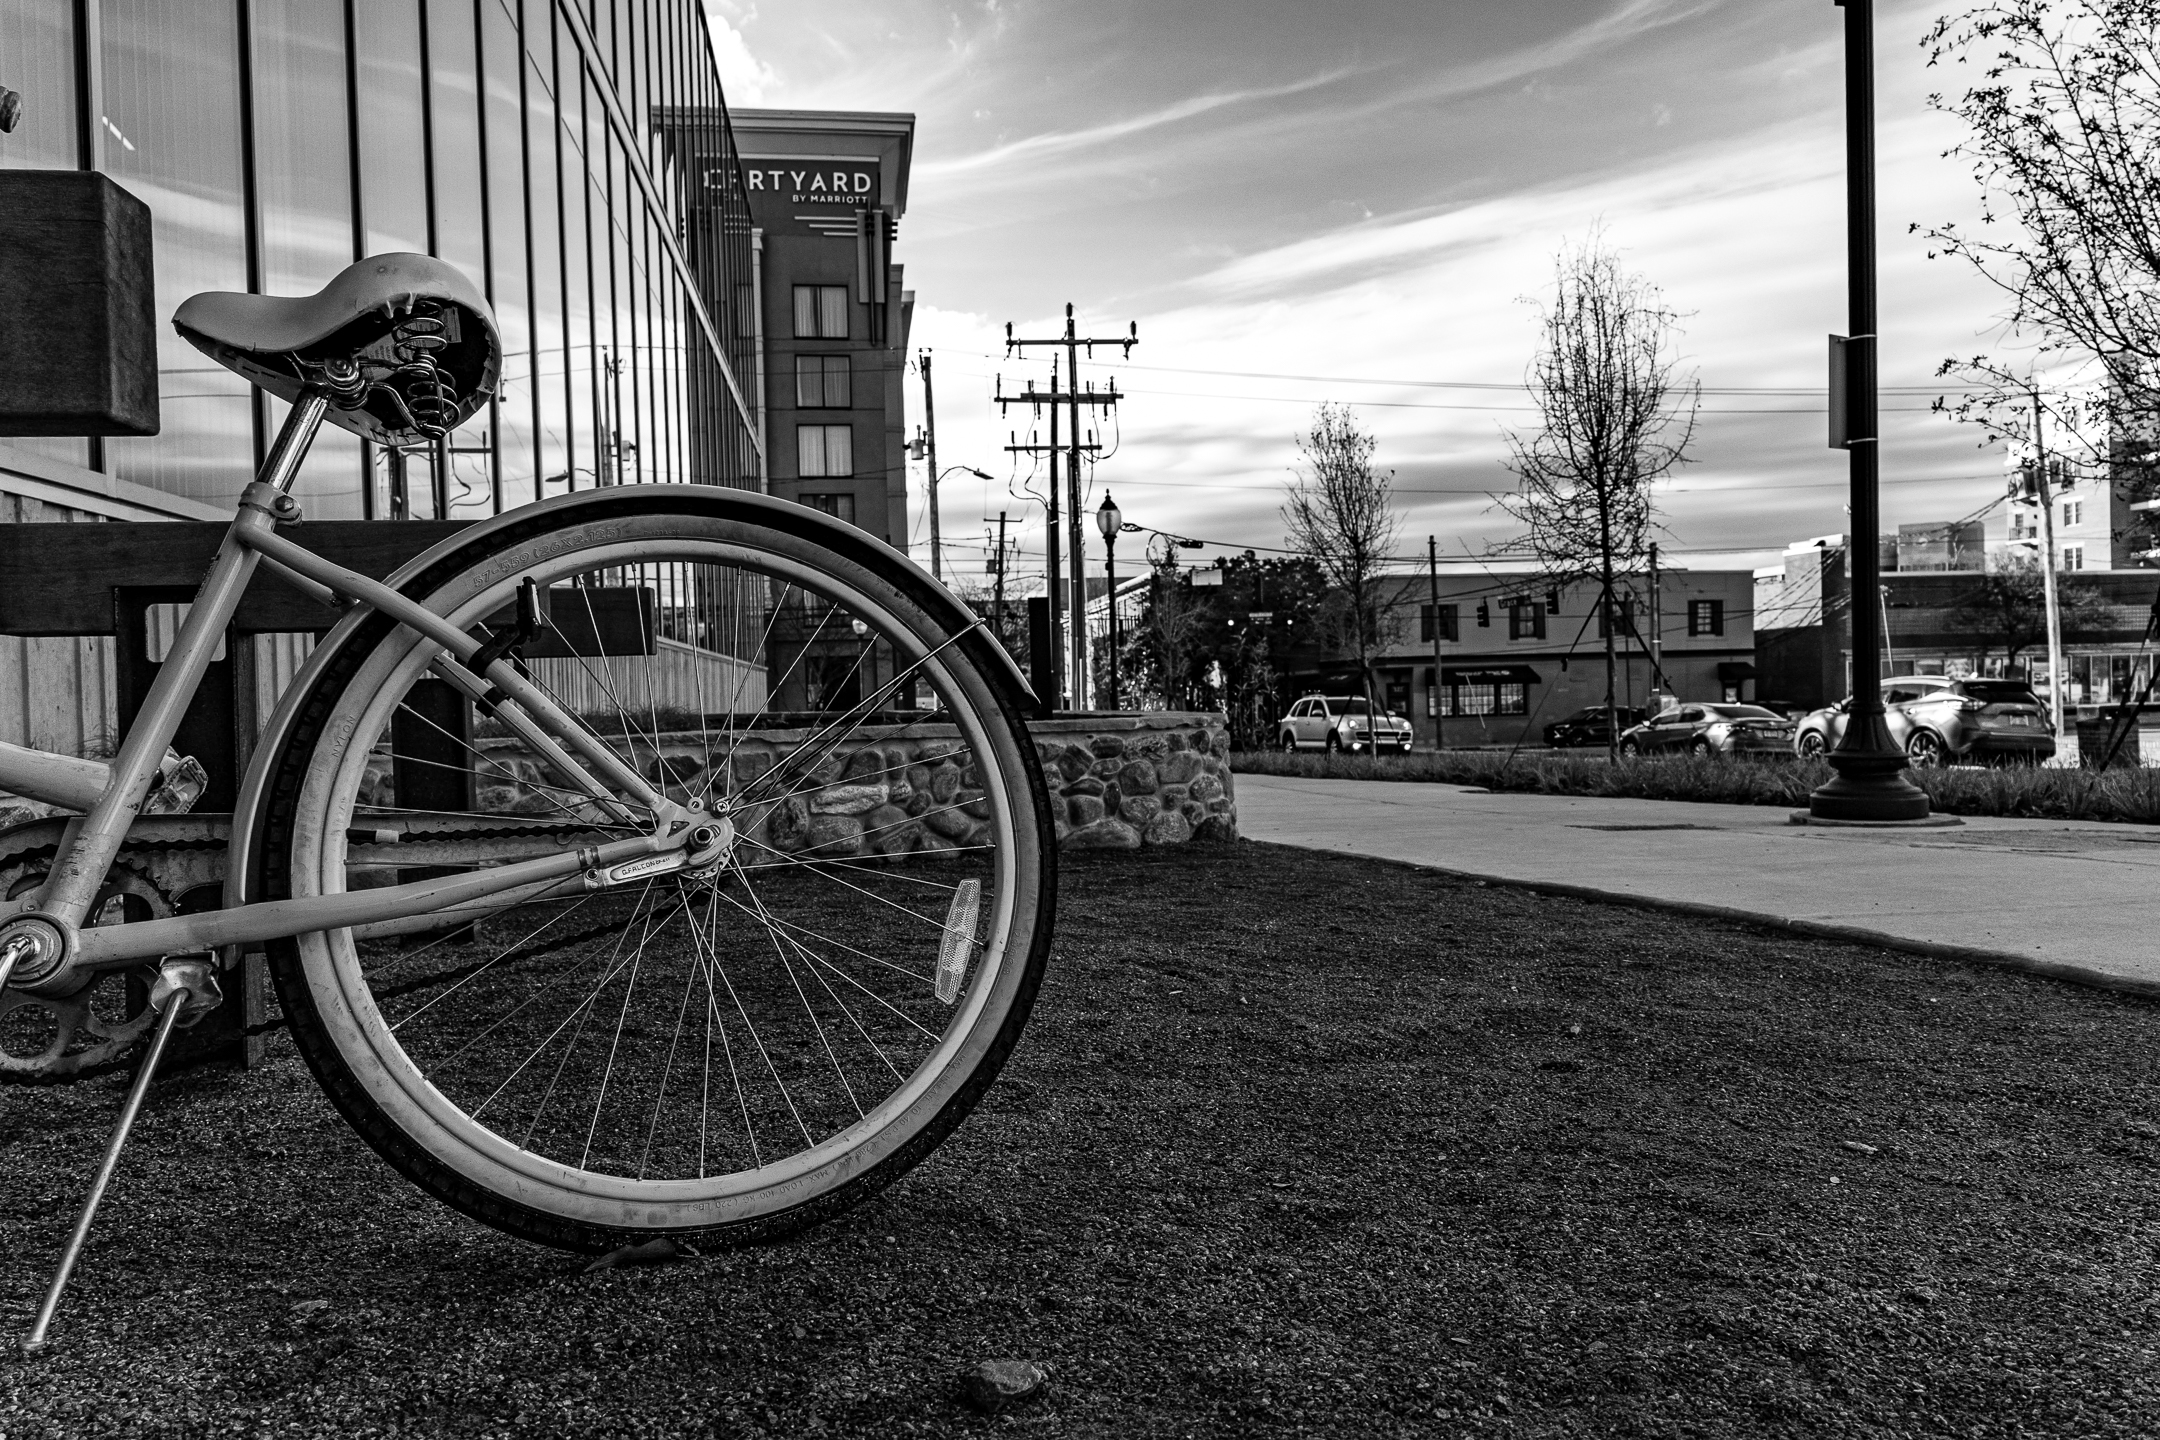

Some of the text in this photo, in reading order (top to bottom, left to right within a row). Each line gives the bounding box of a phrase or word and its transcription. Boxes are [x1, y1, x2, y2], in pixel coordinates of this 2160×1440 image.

[792, 194, 868, 204] BY MARRIOTT
[470, 550, 532, 588] 57-559
[331, 715, 356, 758] NYLON
[805, 1168, 828, 1184] MAX.
[778, 1179, 803, 1194] LOAD
[742, 1194, 756, 1203] KG
[759, 1188, 774, 1199] 100
[714, 1198, 738, 1209] (220
